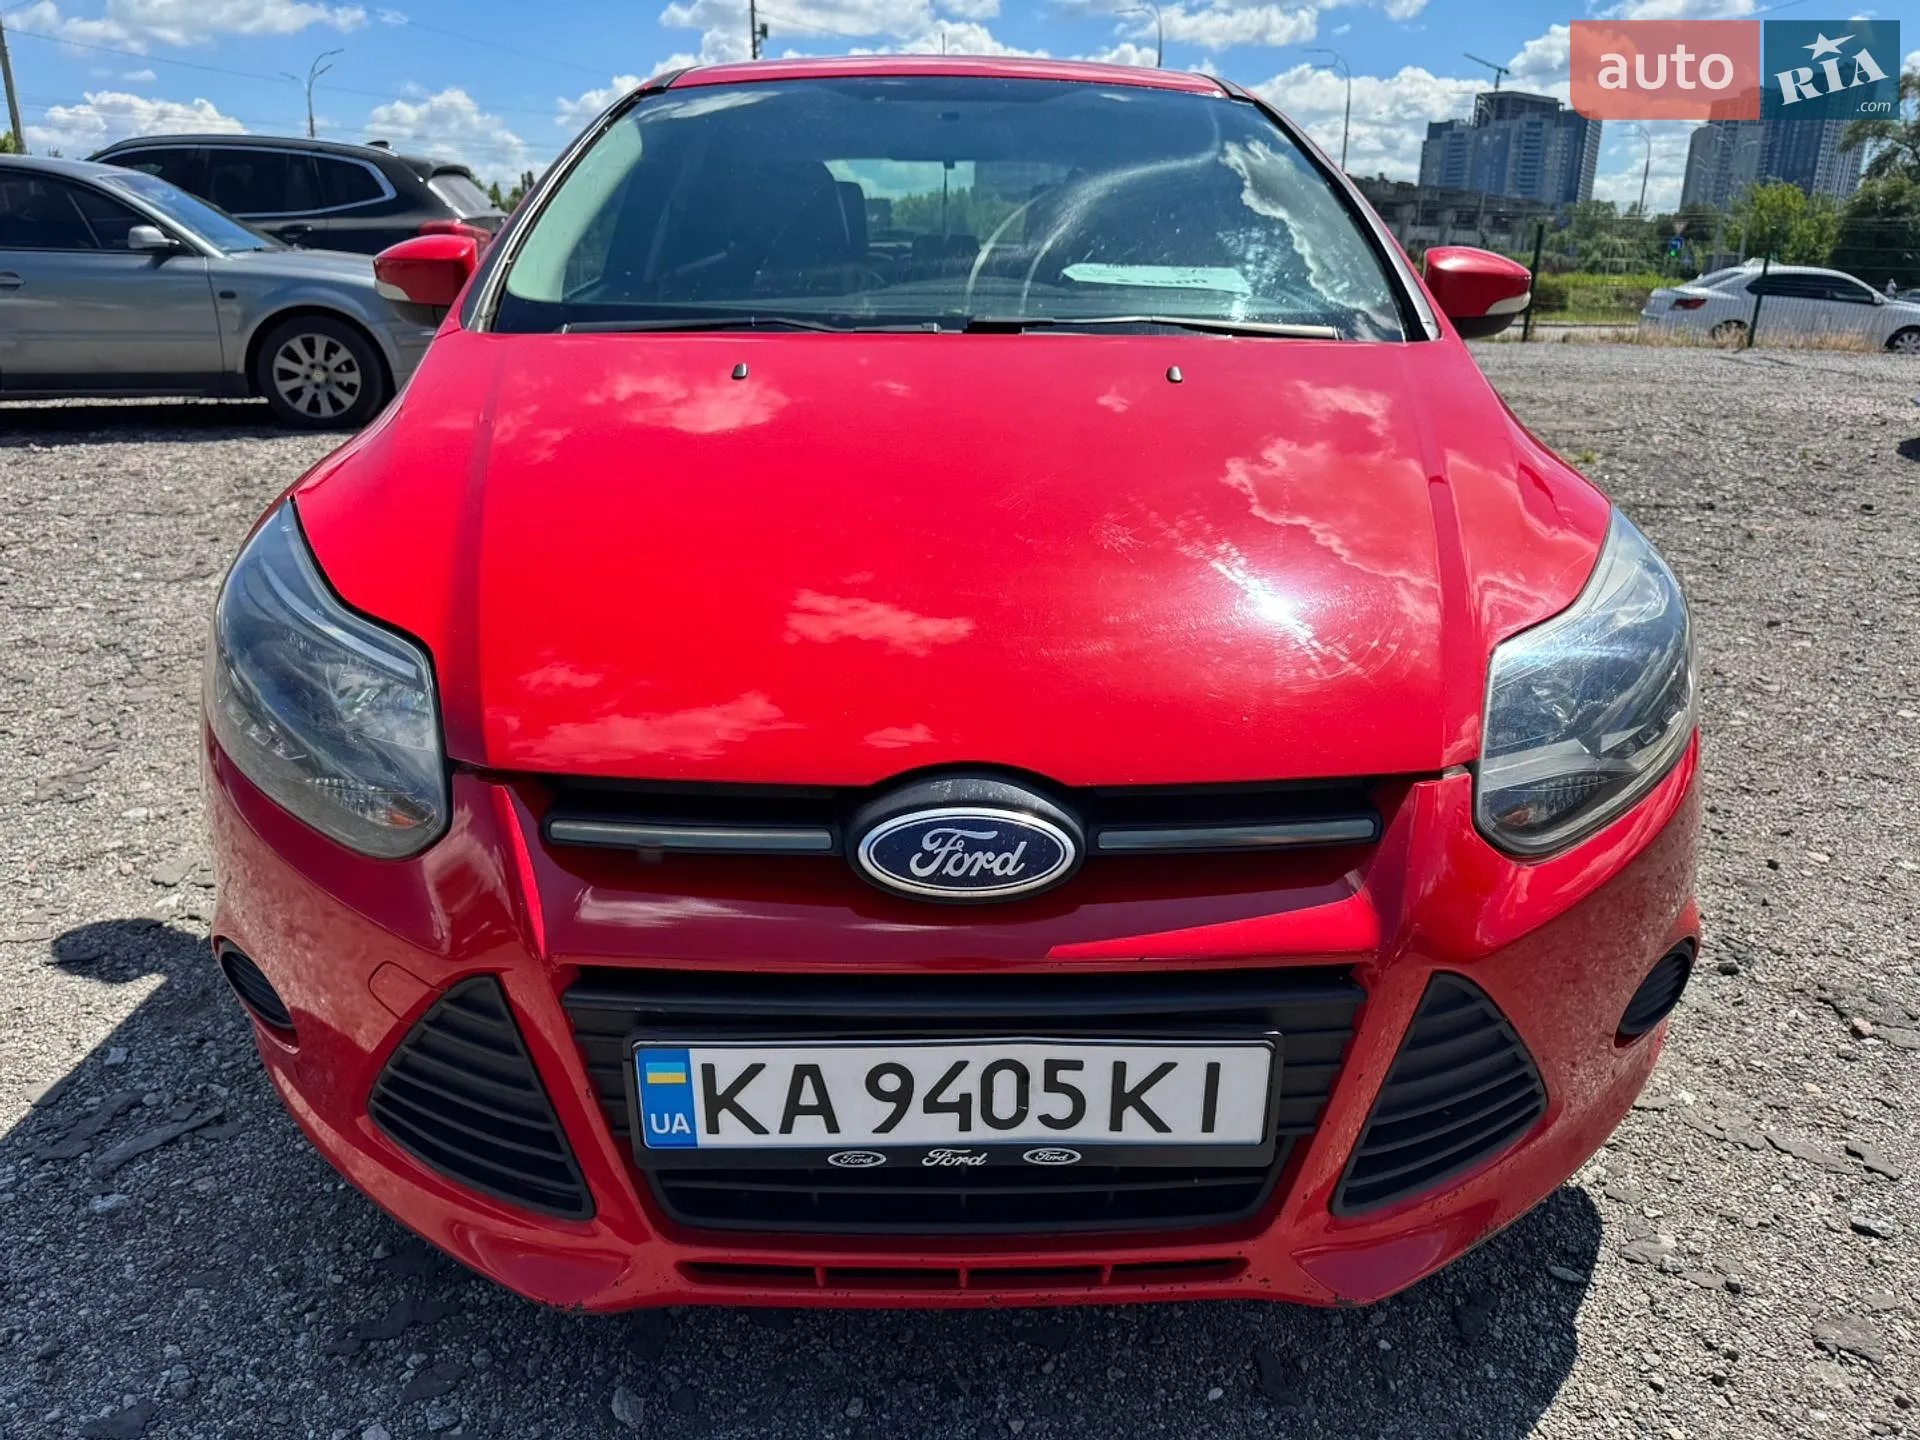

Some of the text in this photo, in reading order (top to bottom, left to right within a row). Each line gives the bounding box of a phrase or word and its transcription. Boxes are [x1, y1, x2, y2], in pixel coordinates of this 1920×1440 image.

[909, 828, 1028, 877] Ford
[701, 1060, 1220, 1135] KA 9405 KI
[651, 1112, 691, 1134] UA
[840, 1154, 874, 1165] Ford
[921, 1149, 988, 1167] Ford
[1034, 1151, 1069, 1163] Ford
